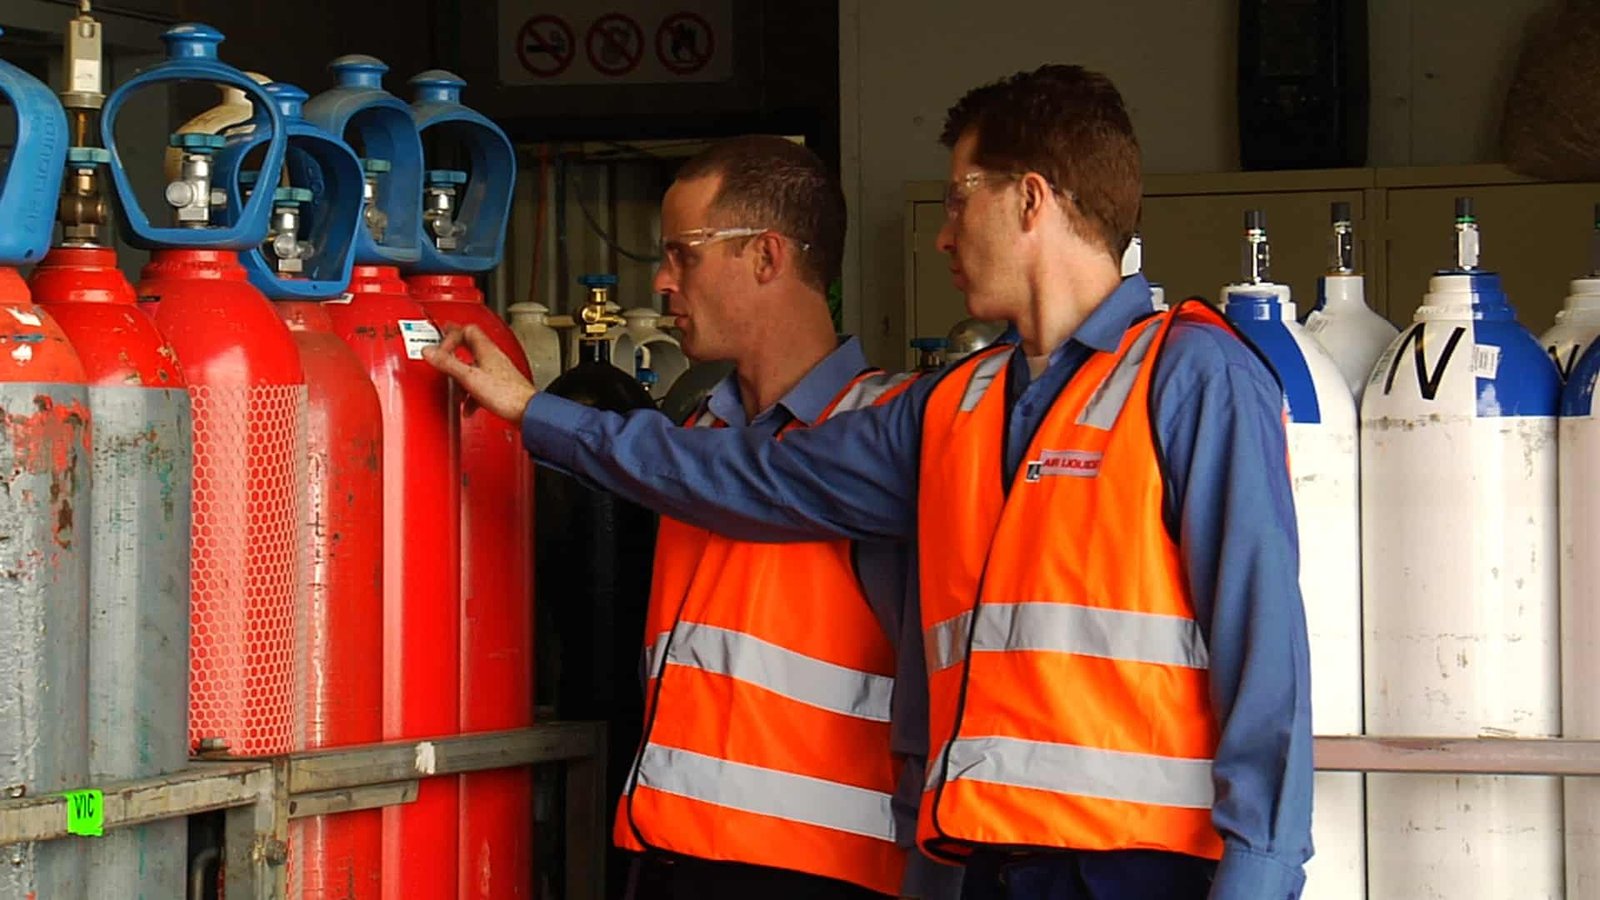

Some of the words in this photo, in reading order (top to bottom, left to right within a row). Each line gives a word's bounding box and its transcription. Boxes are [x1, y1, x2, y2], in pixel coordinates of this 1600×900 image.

[1383, 322, 1467, 400] N
[1043, 458, 1060, 467] AIR
[73, 793, 95, 819] VIC
